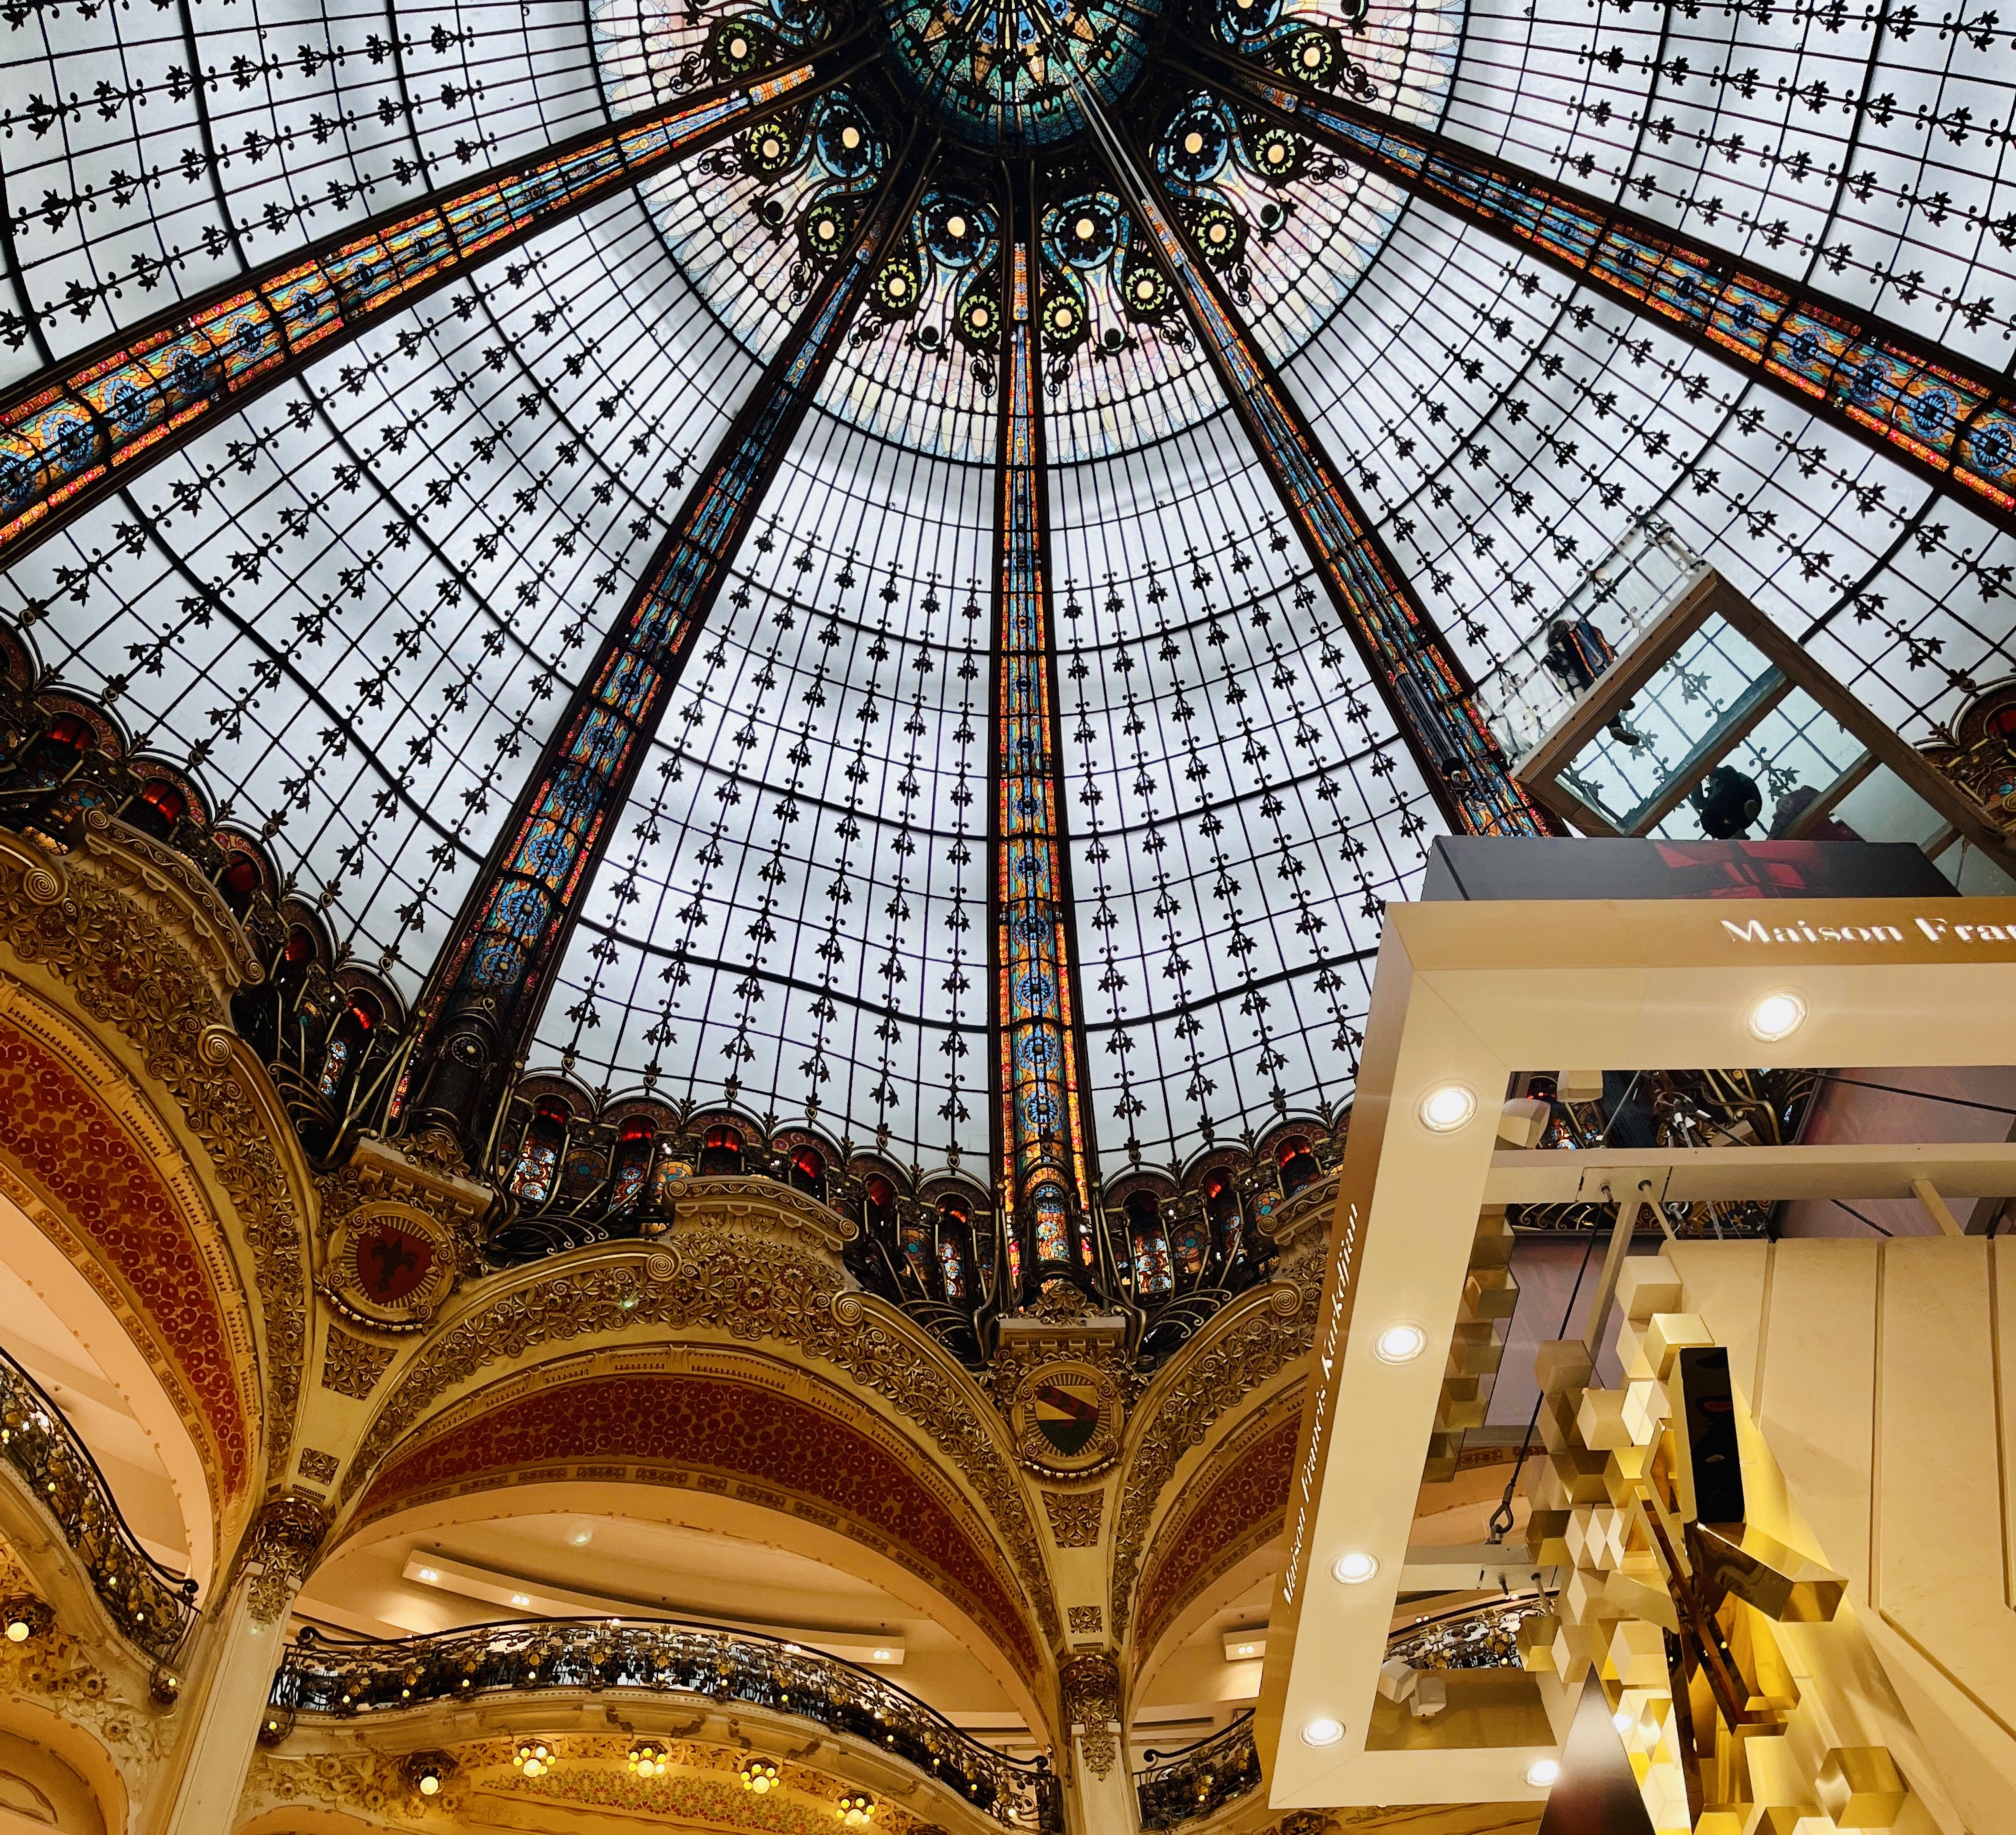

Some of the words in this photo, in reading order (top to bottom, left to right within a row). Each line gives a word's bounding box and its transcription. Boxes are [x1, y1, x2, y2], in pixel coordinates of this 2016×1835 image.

[1719, 918, 1904, 943] Maison
[1283, 1506, 1306, 1614] Maison
[1301, 1384, 1327, 1504] Francis
[1321, 1202, 1358, 1381] Kurkdjian
